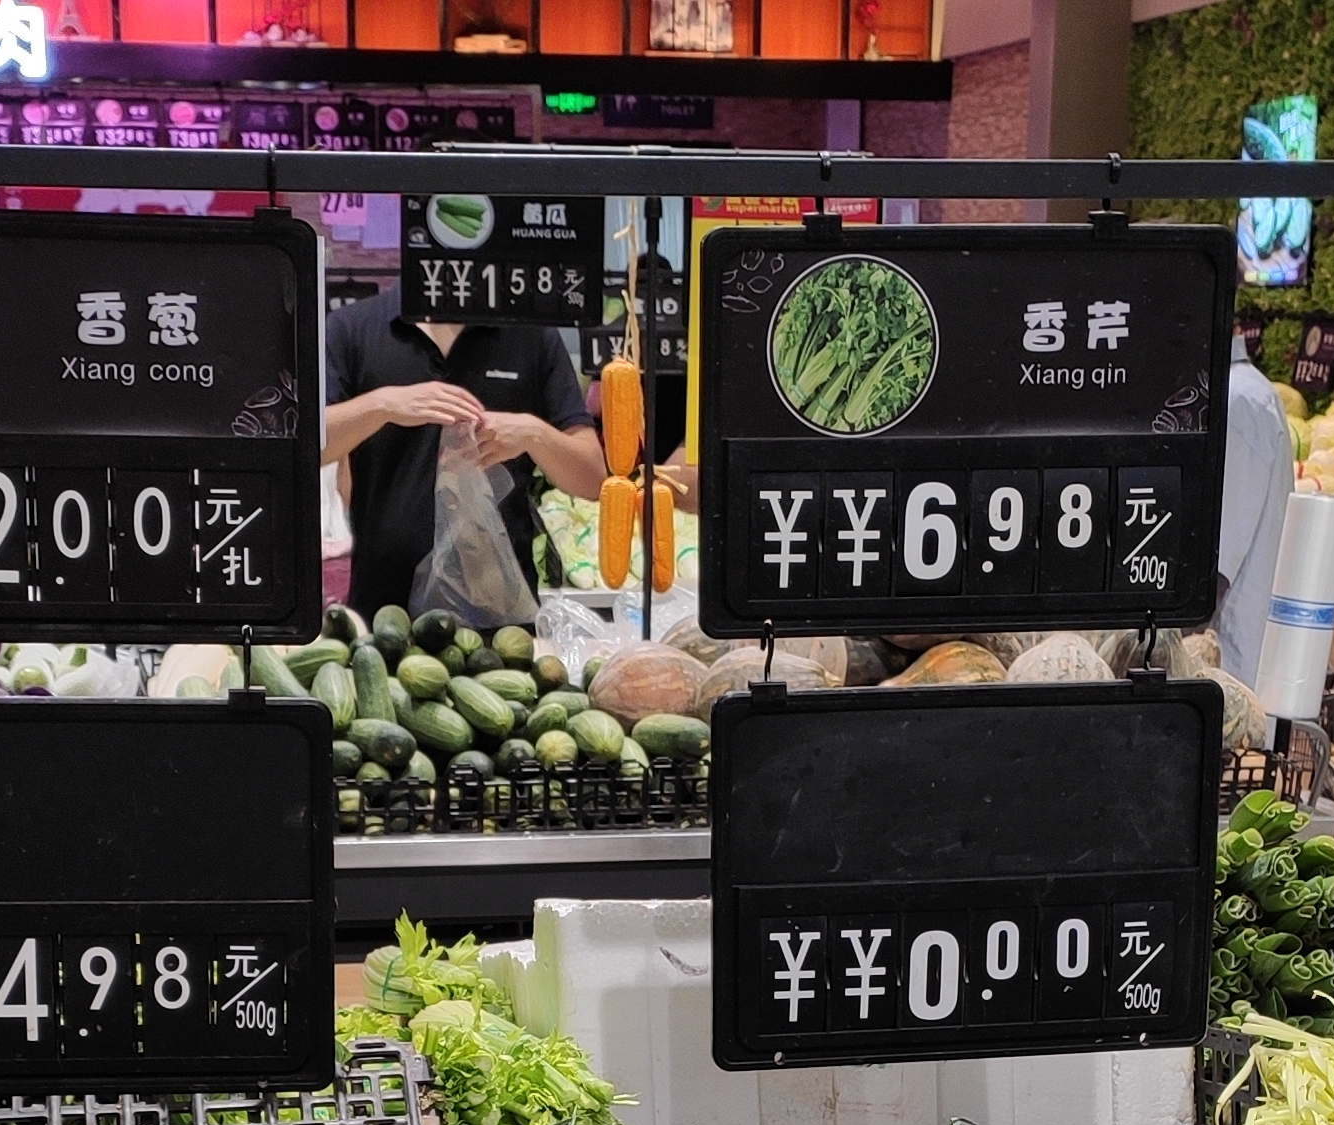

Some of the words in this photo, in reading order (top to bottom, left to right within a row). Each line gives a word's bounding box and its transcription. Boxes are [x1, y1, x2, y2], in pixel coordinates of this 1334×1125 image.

[512, 228, 552, 239] HUANG
[553, 229, 577, 239] GUA
[76, 291, 199, 346] 香葱
[1022, 300, 1131, 352] 香芹
[61, 356, 135, 386] Xiang
[149, 363, 214, 388] cong
[1019, 363, 1085, 390] Xiang
[1091, 363, 1127, 391] qin
